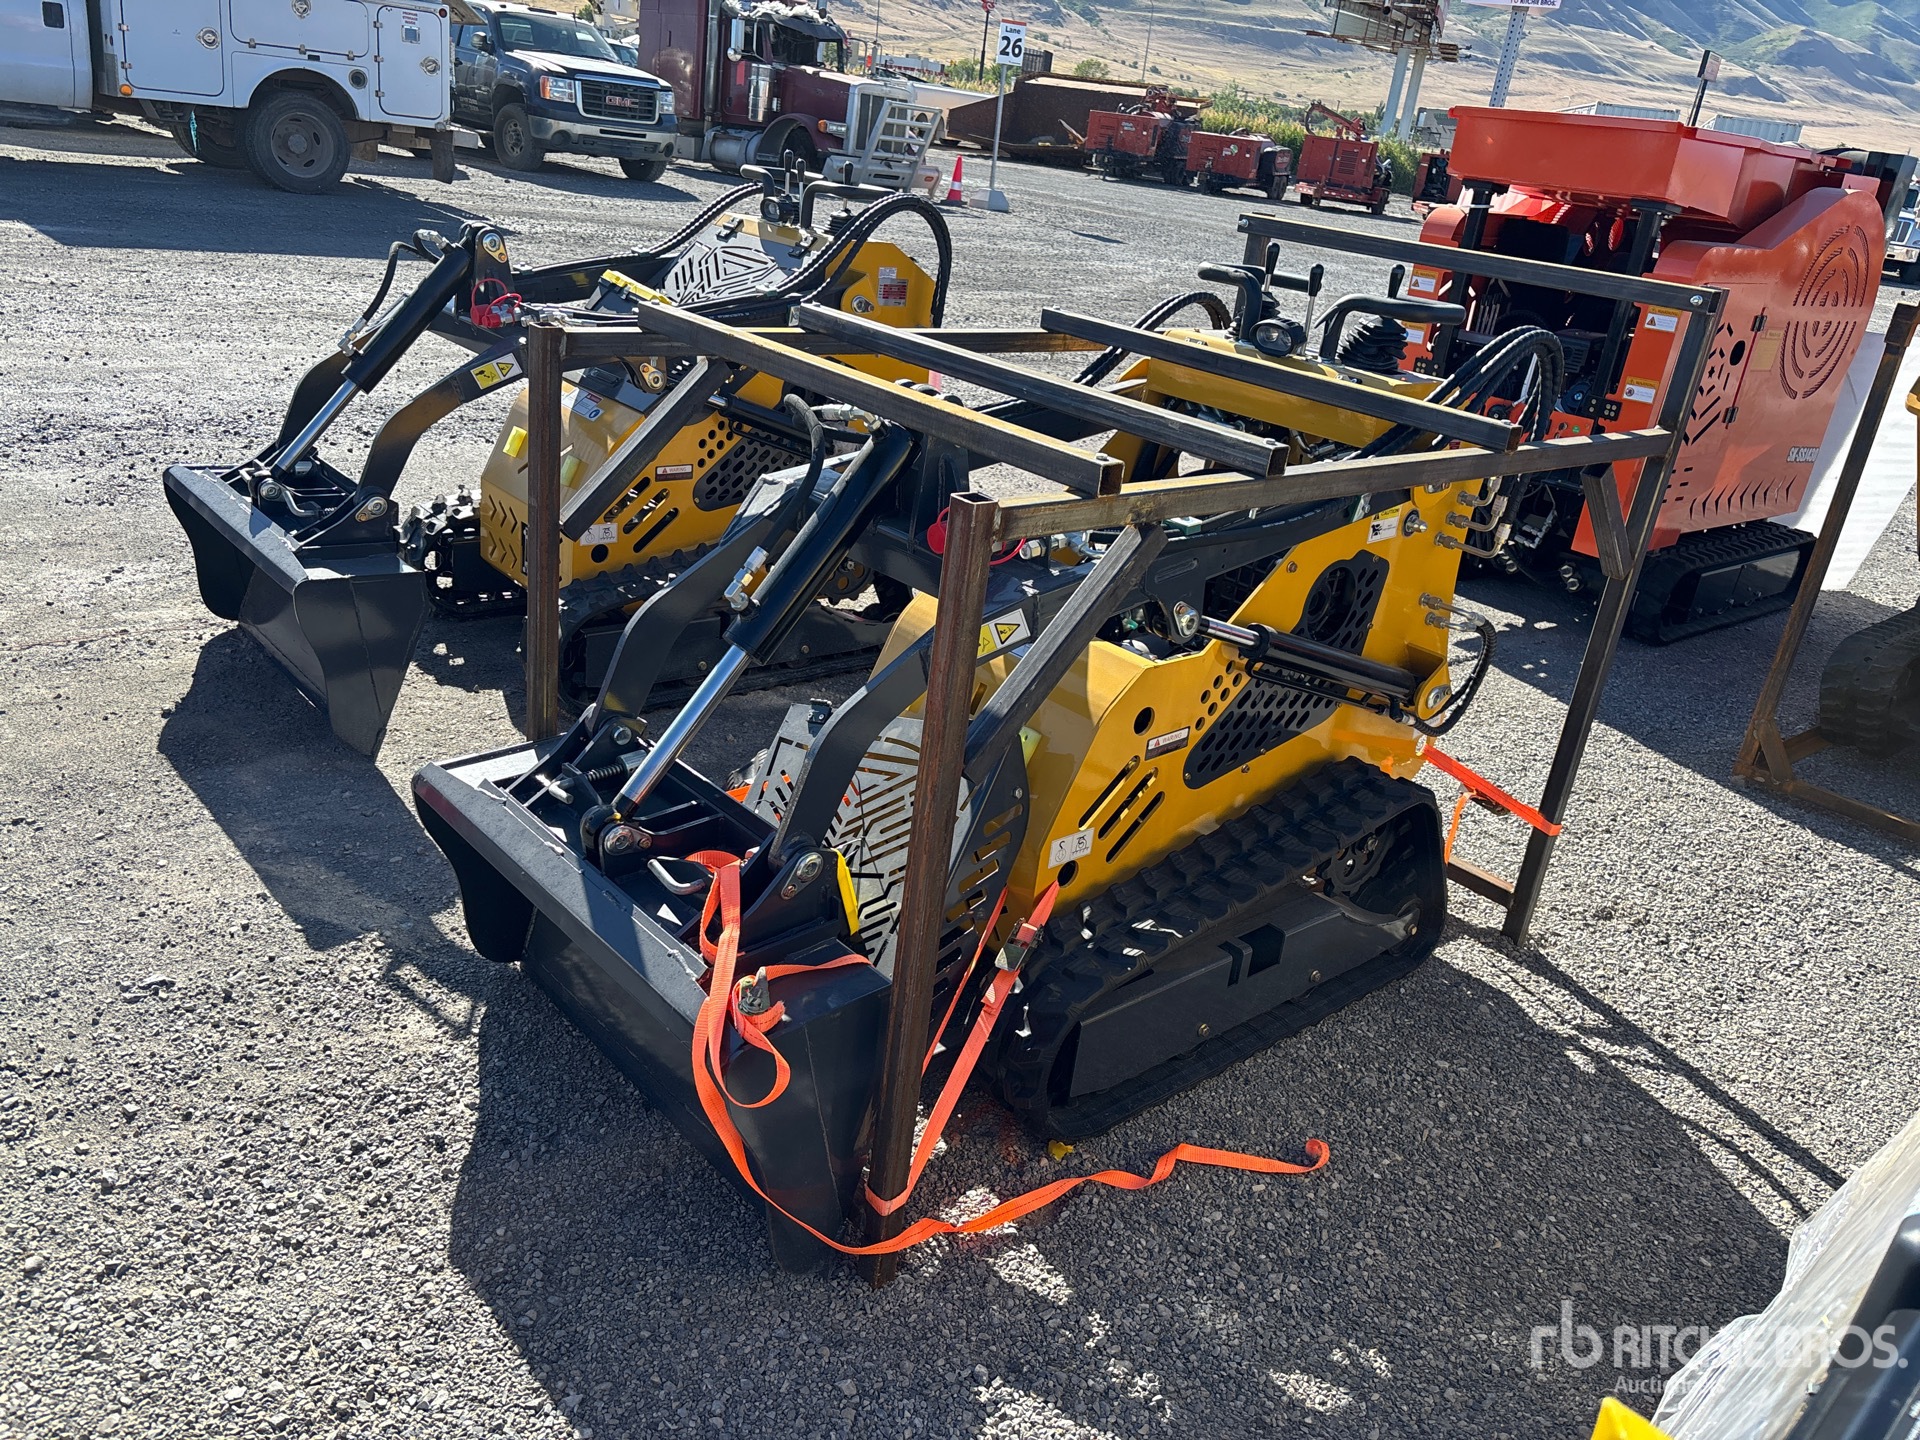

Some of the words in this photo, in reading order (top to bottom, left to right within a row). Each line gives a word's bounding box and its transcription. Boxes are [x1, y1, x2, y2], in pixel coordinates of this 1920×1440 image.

[1005, 26, 1021, 34] Lane
[999, 35, 1022, 58] 26
[606, 95, 638, 108] GMC
[1162, 732, 1183, 744] WARING
